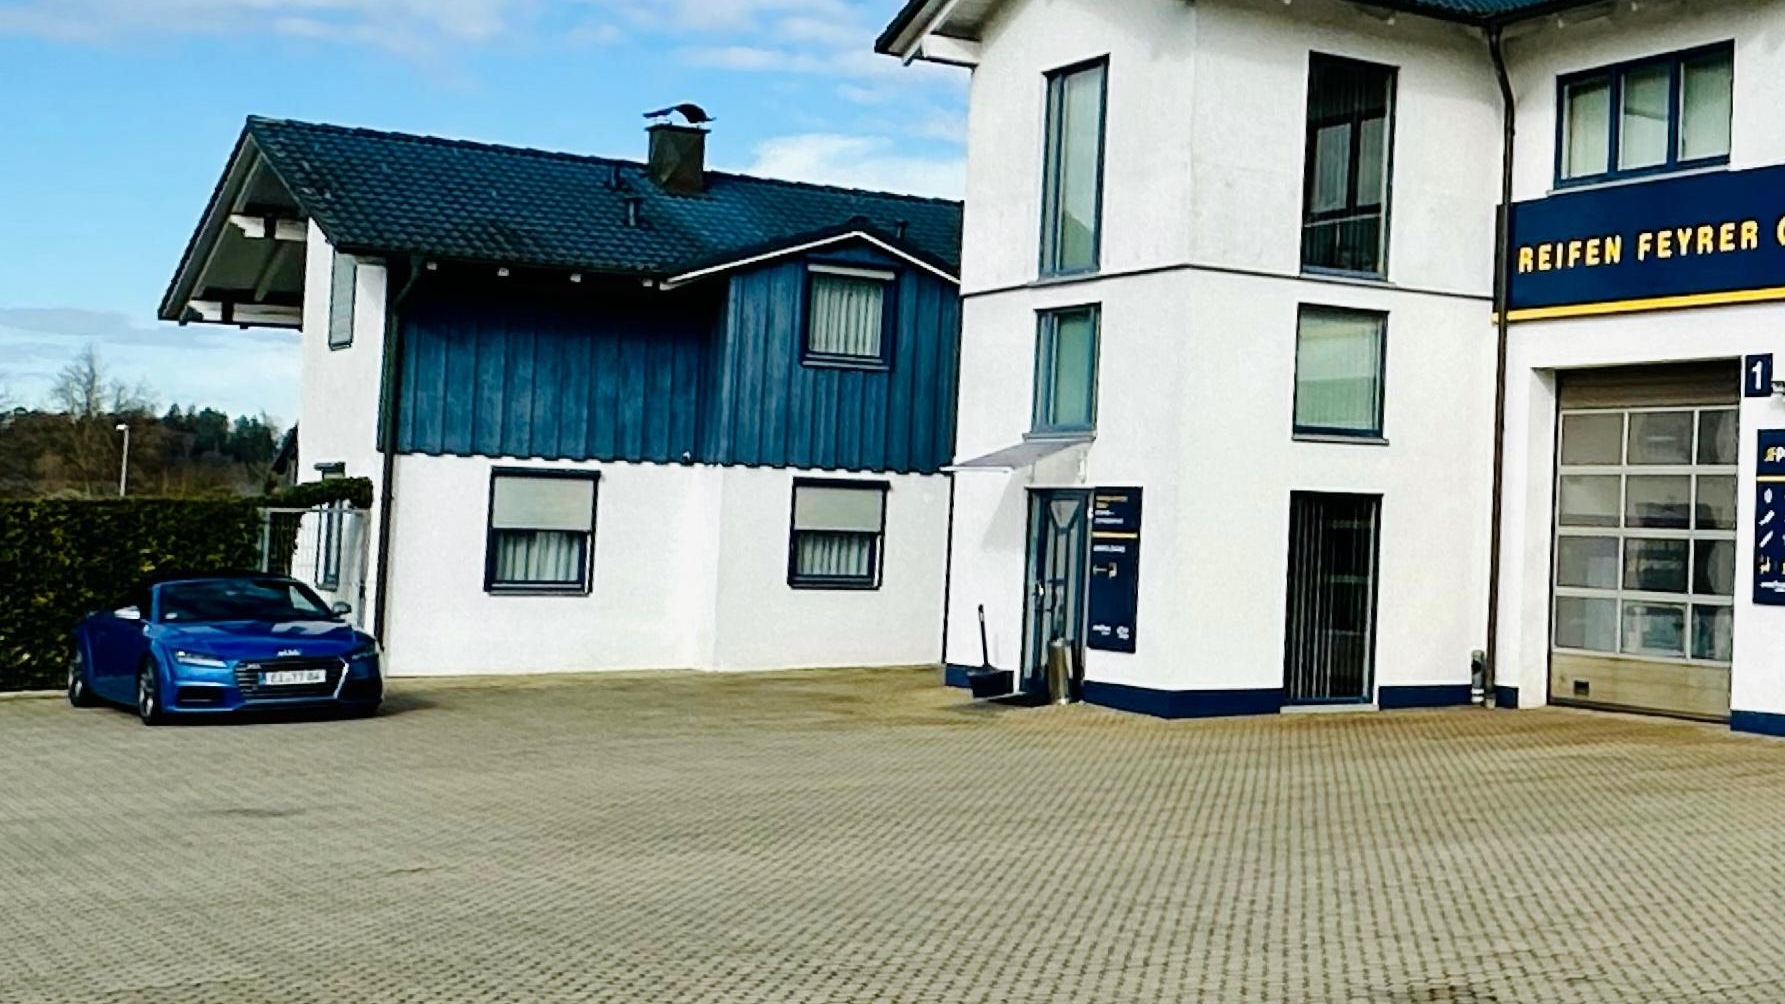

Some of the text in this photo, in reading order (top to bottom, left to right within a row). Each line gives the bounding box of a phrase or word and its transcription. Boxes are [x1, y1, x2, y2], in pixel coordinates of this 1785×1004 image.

[1517, 234, 1622, 273] REIFEN
[1637, 220, 1760, 261] FEYRER
[1751, 360, 1764, 390] 1
